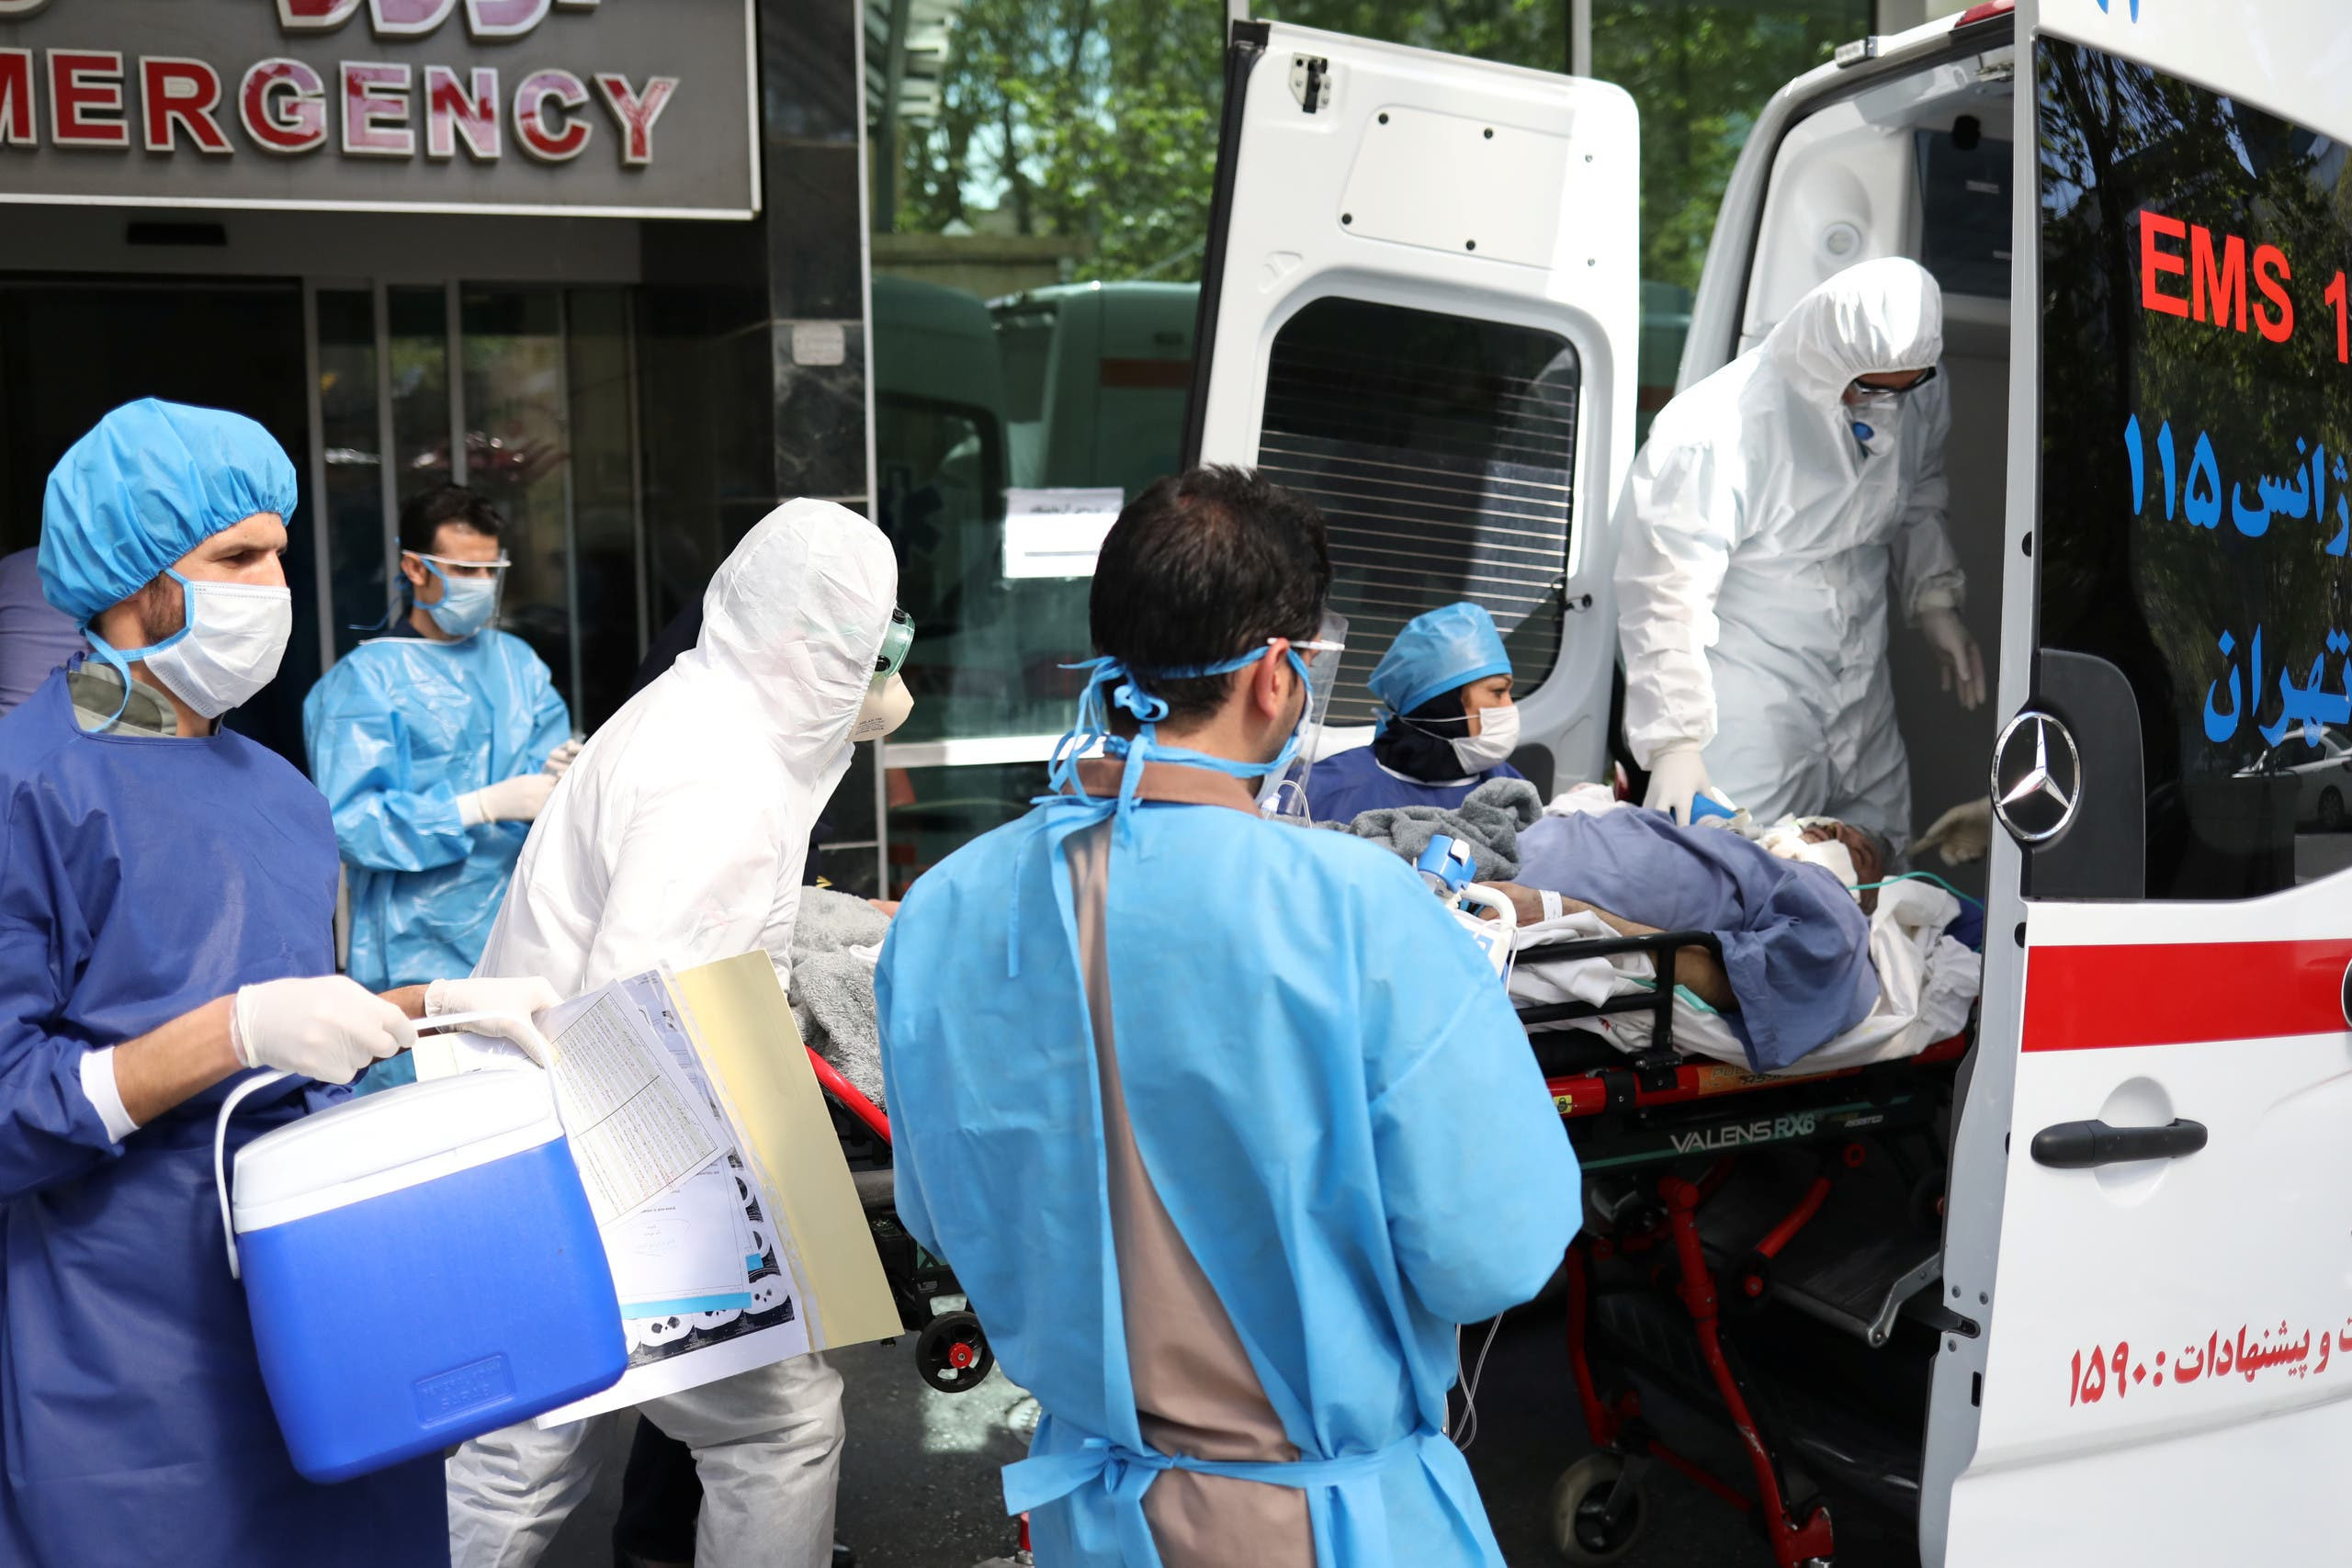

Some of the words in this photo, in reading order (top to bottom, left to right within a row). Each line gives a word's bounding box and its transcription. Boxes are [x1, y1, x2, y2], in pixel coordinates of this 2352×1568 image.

[2140, 209, 2294, 344] EMS
[2123, 412, 2223, 530] ۱۱۵
[2203, 623, 2352, 748] تهران
[1668, 1119, 1772, 1154] VALENS
[2312, 1330, 2332, 1375] و
